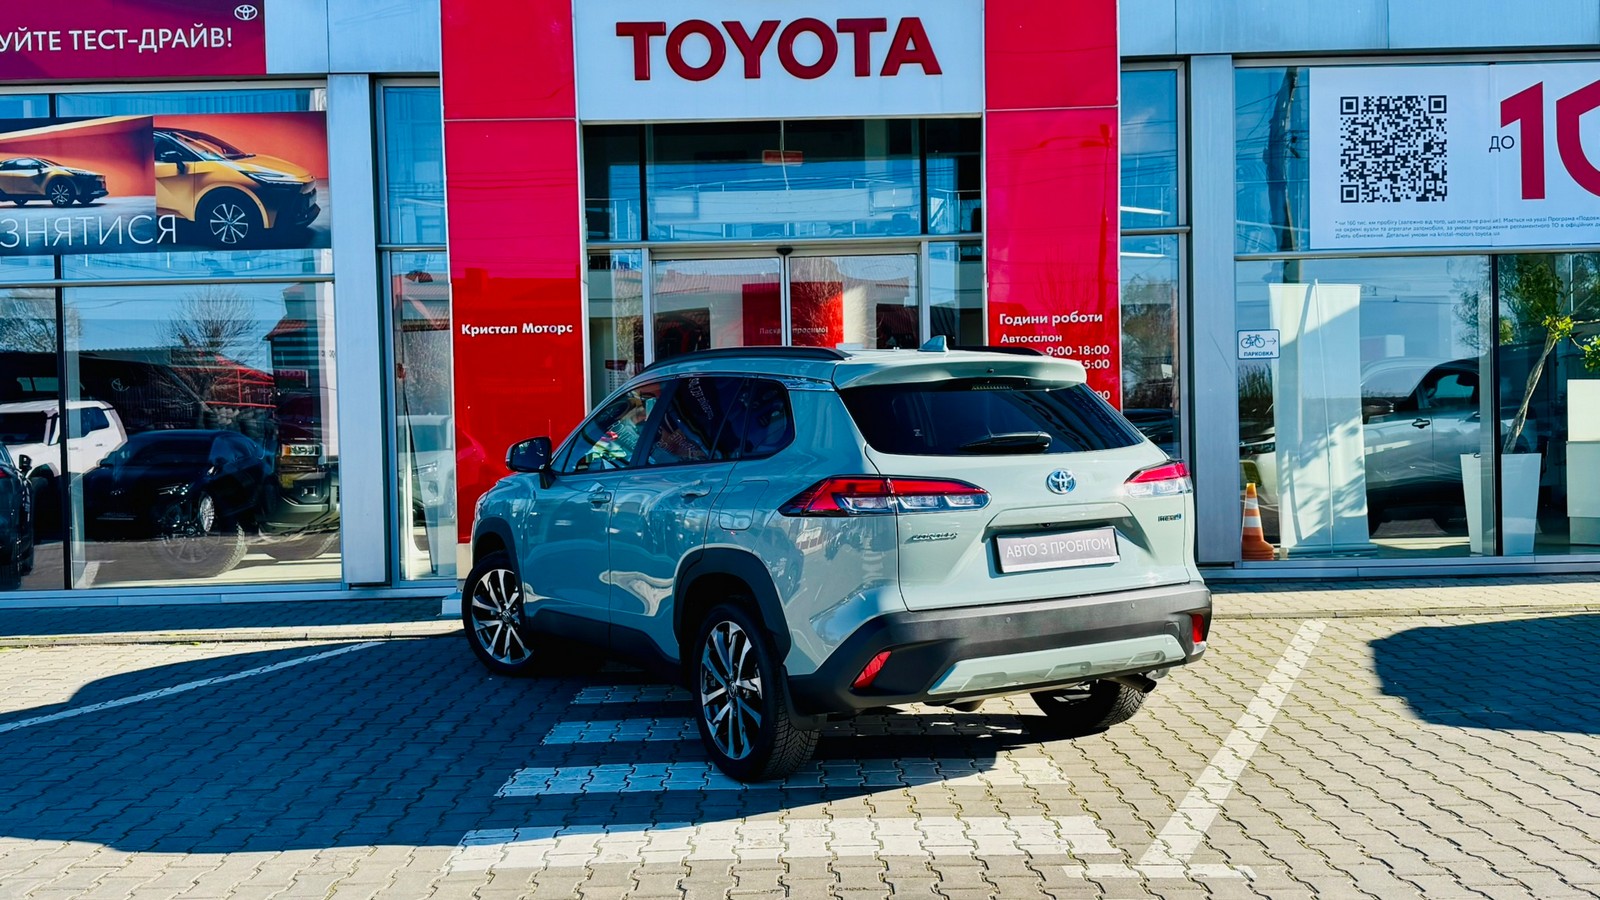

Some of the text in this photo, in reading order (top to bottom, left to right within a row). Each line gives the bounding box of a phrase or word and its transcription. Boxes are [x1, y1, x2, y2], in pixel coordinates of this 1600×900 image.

[69, 23, 233, 53] ТЕСТ-ДРАЙВ!
[616, 17, 943, 82] TOYOTA
[0, 214, 177, 248] ЗНЯТИСЯ
[999, 311, 1103, 327] Години роботи
[461, 322, 573, 337] Кристал Моторс
[1000, 333, 1062, 344] Автосалон
[1006, 538, 1111, 558] АВТО З ПРОБІГОМ
